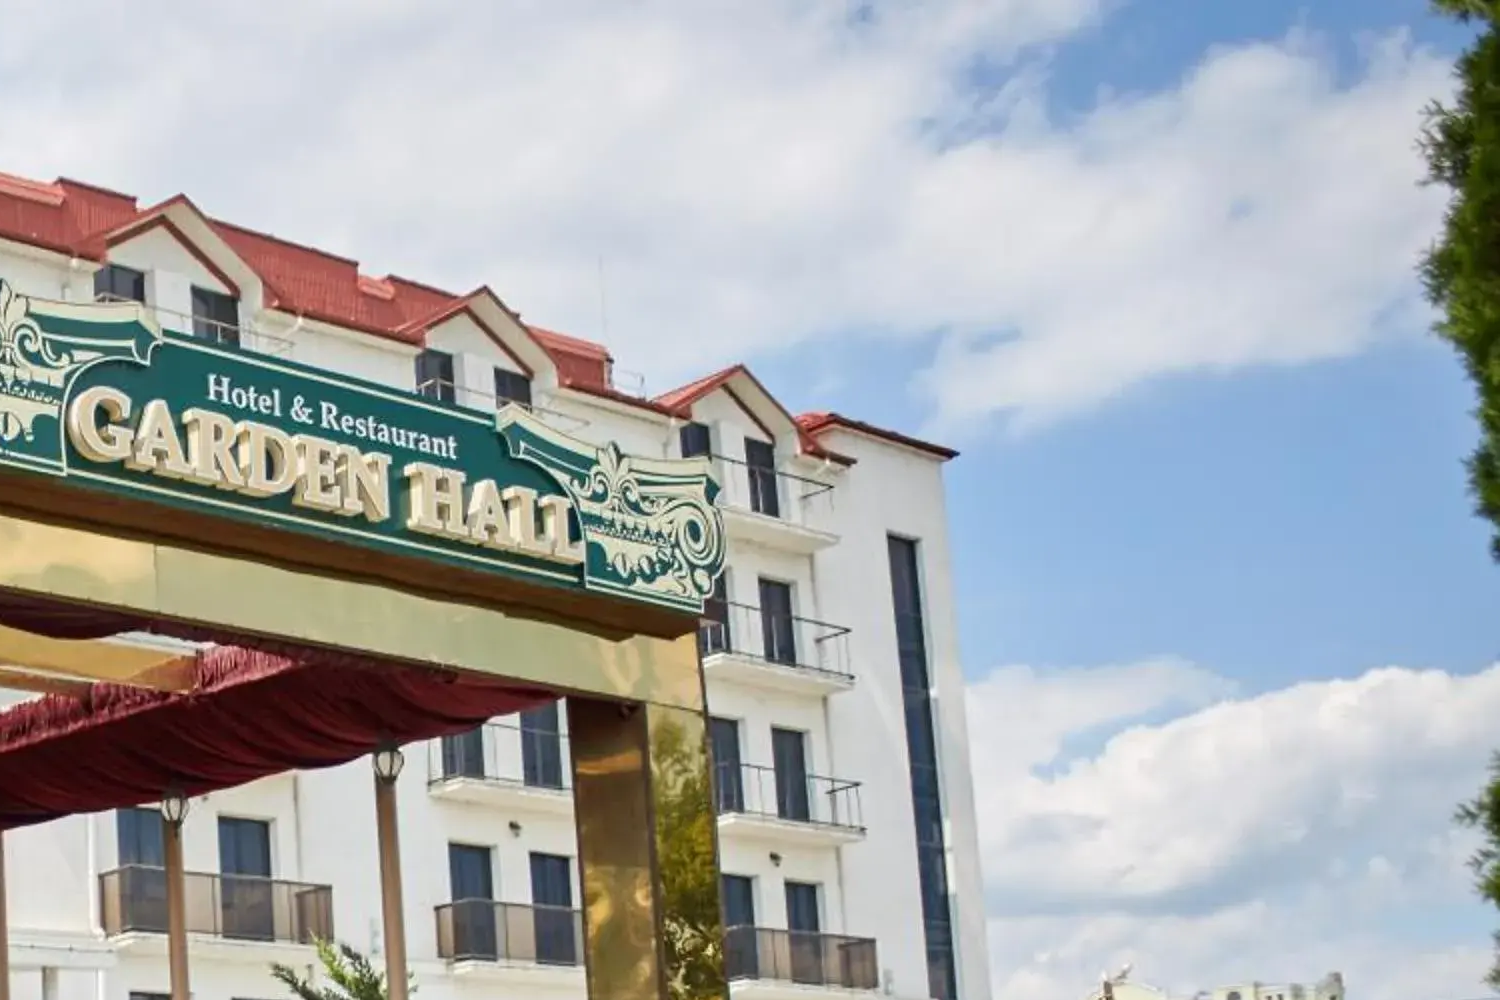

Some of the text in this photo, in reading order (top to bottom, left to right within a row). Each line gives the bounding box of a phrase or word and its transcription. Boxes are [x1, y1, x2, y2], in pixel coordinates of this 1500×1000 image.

[68, 386, 585, 565] GARDEN HALL
[207, 373, 458, 460] Hotel & Restaurant
